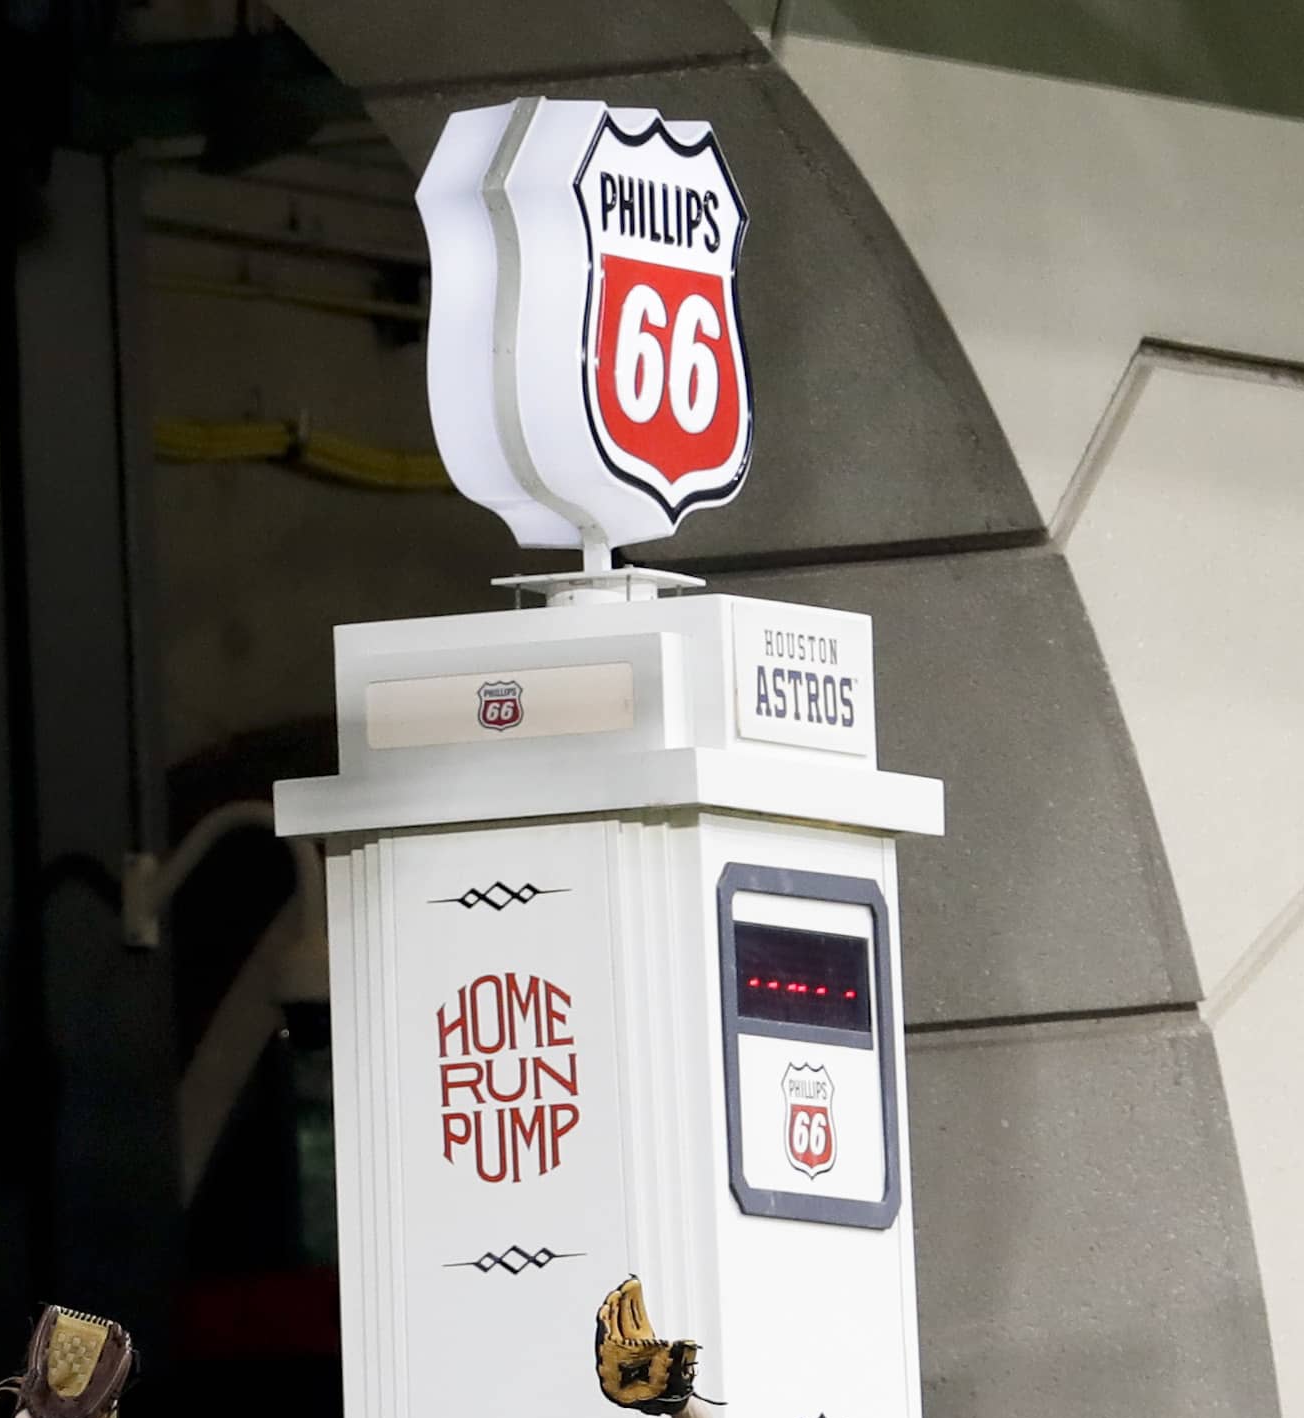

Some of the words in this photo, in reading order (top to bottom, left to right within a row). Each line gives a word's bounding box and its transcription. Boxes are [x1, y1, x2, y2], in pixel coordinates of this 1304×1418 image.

[600, 170, 721, 254] PHILLIPS
[614, 283, 722, 435] 66
[764, 629, 838, 665] HOUSTON
[486, 701, 514, 721] 66
[755, 664, 855, 728] ASTROS
[436, 972, 575, 1059] HOME
[439, 1053, 579, 1108] RUN
[788, 1079, 828, 1101] PHILLIPS
[441, 1103, 580, 1183] PUMP
[792, 1110, 828, 1156] 66
